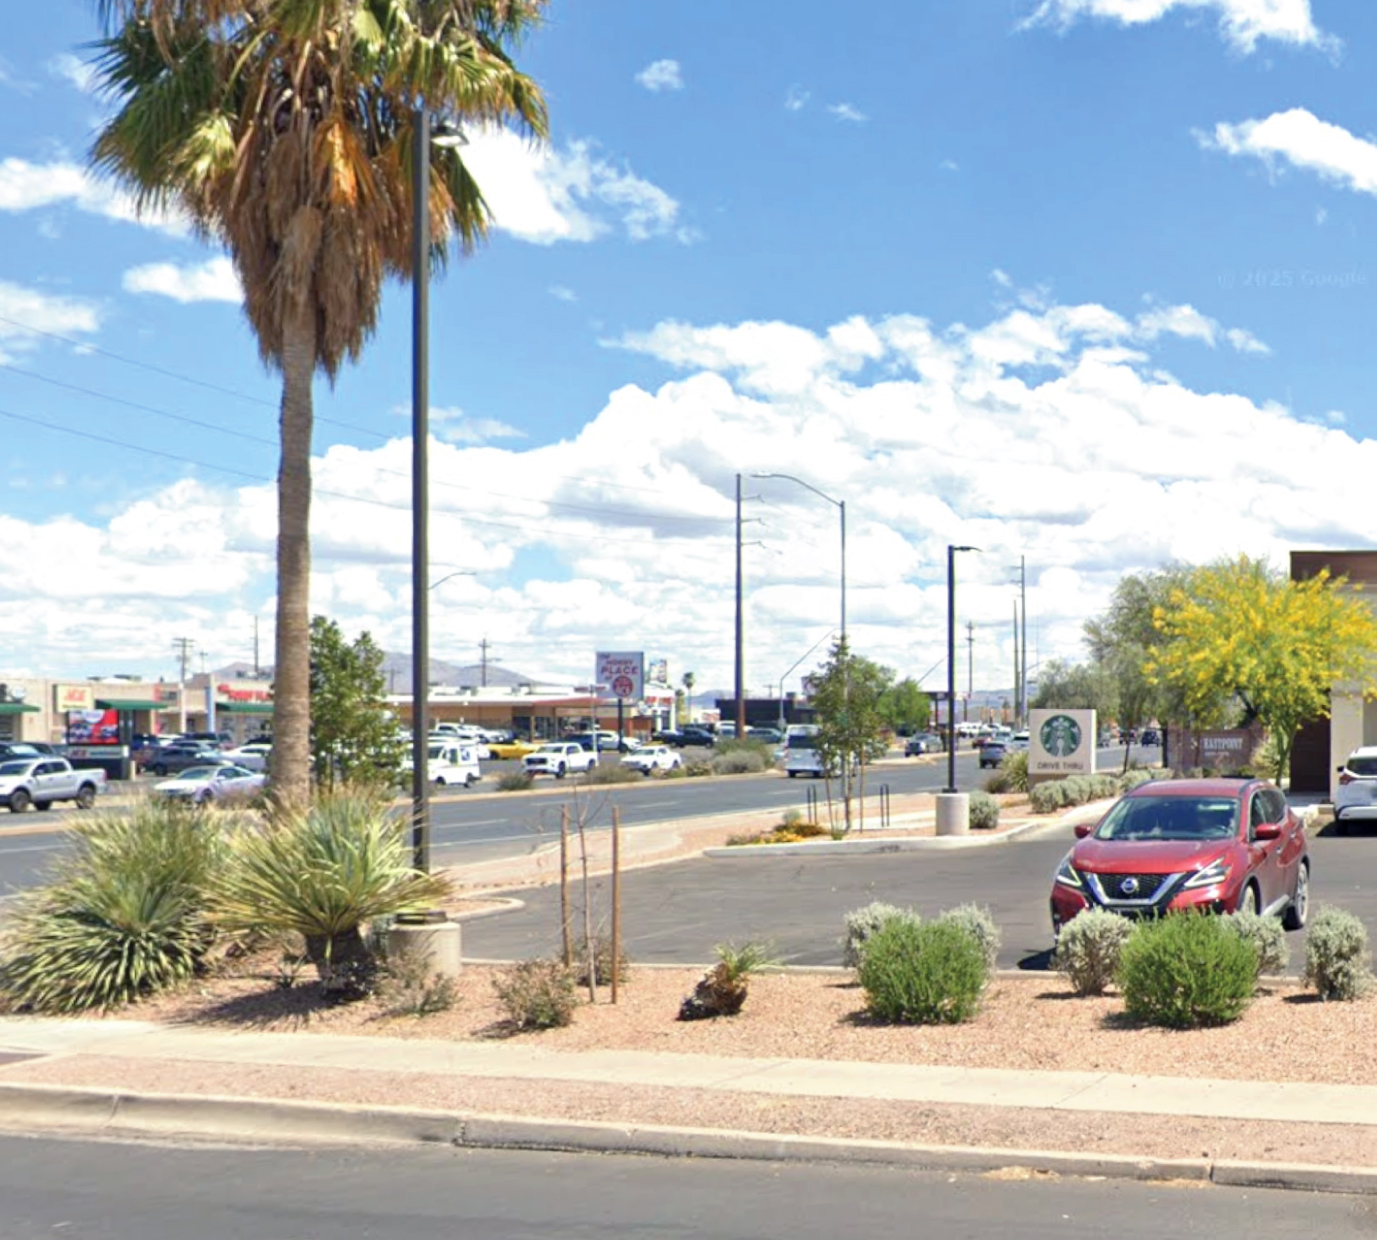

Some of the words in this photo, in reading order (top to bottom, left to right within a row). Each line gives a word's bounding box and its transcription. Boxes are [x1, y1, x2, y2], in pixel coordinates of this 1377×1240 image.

[601, 666, 639, 676] PLACE
[1037, 761, 1060, 770] DRIVE
[1062, 761, 1084, 770] THRU
